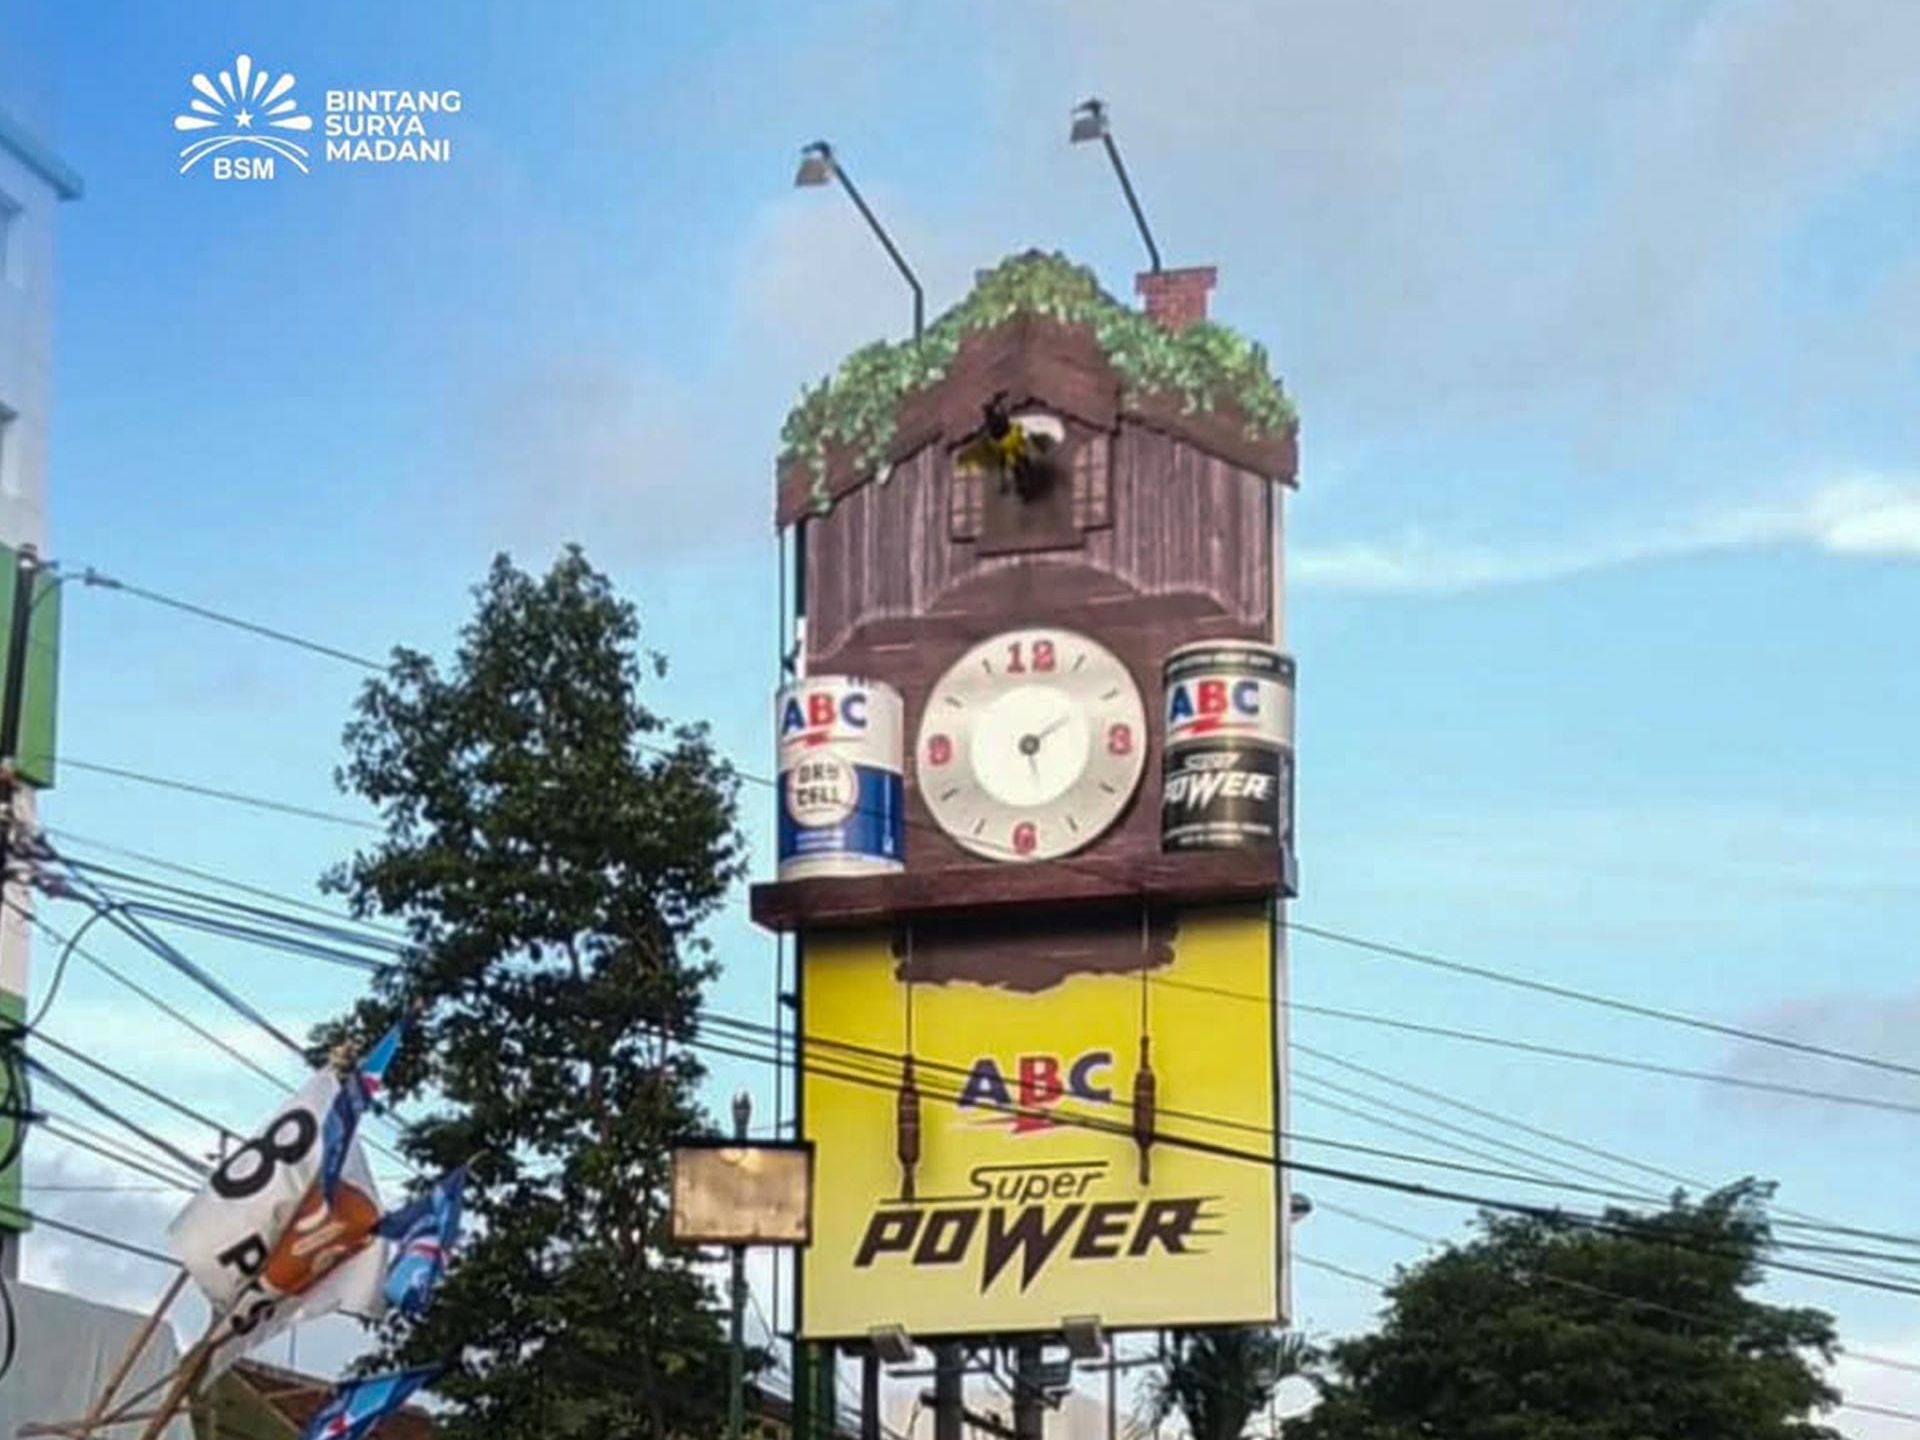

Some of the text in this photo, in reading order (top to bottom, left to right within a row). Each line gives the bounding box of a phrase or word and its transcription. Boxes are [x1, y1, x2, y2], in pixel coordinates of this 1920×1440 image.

[782, 693, 868, 735] ABC
[1169, 679, 1261, 722] ABC
[1012, 821, 1037, 855] 6
[957, 1051, 1114, 1108] ABC
[210, 1108, 318, 1200] 8
[969, 1160, 1109, 1205] Super
[852, 1197, 1212, 1295] POWER
